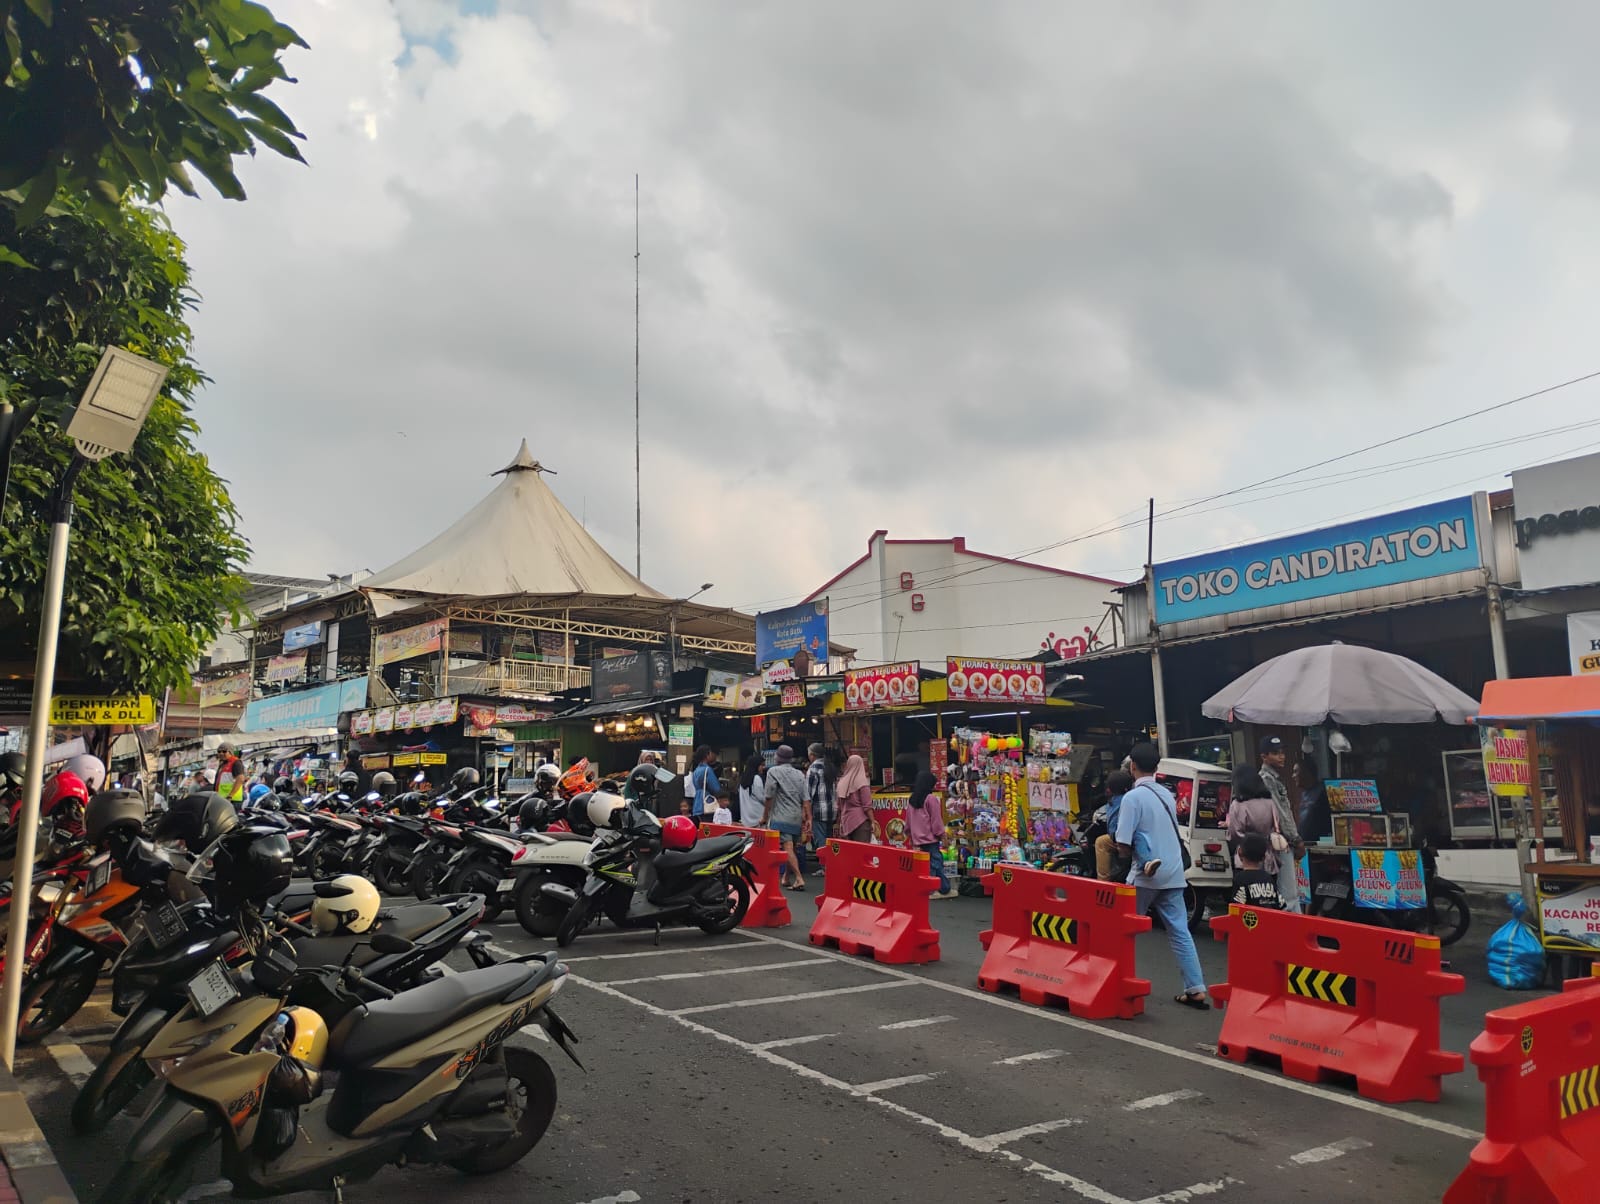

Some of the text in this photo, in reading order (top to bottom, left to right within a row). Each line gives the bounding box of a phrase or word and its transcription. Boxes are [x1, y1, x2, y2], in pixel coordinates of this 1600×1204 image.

[1160, 518, 1468, 605] TOKO CANDIRATON
[892, 663, 909, 674] BATU
[960, 660, 1032, 672] UDANG KEJU BATU
[59, 699, 140, 709] PENITIPAN
[54, 710, 145, 720] HELM & DLL
[259, 696, 322, 725] FOODCOURT
[1487, 761, 1516, 783] JAGUNG
[1358, 869, 1386, 879] TELUR
[1398, 870, 1420, 880] TELUR
[1355, 879, 1392, 890] GULUNG
[1396, 880, 1423, 891] GULUNG
[1543, 909, 1600, 921] KACANG
